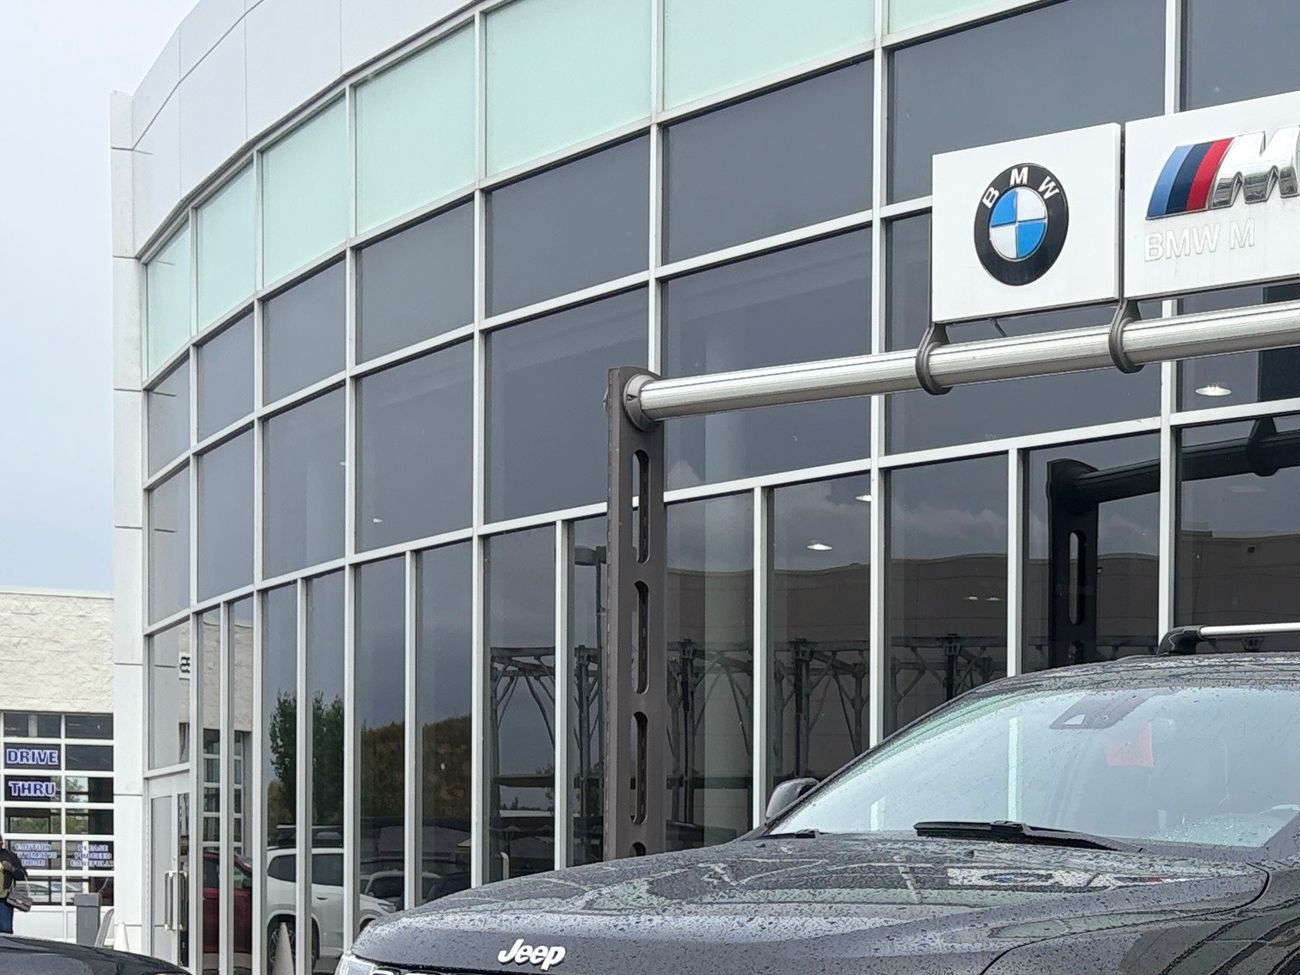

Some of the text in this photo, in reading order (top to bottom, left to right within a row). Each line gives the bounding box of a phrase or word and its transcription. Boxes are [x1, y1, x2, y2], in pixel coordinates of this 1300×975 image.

[981, 166, 1060, 209] BMW
[1144, 217, 1256, 262] BMW M
[7, 749, 59, 765] DRIVE
[9, 781, 56, 797] THRU
[498, 938, 566, 971] Jeep
